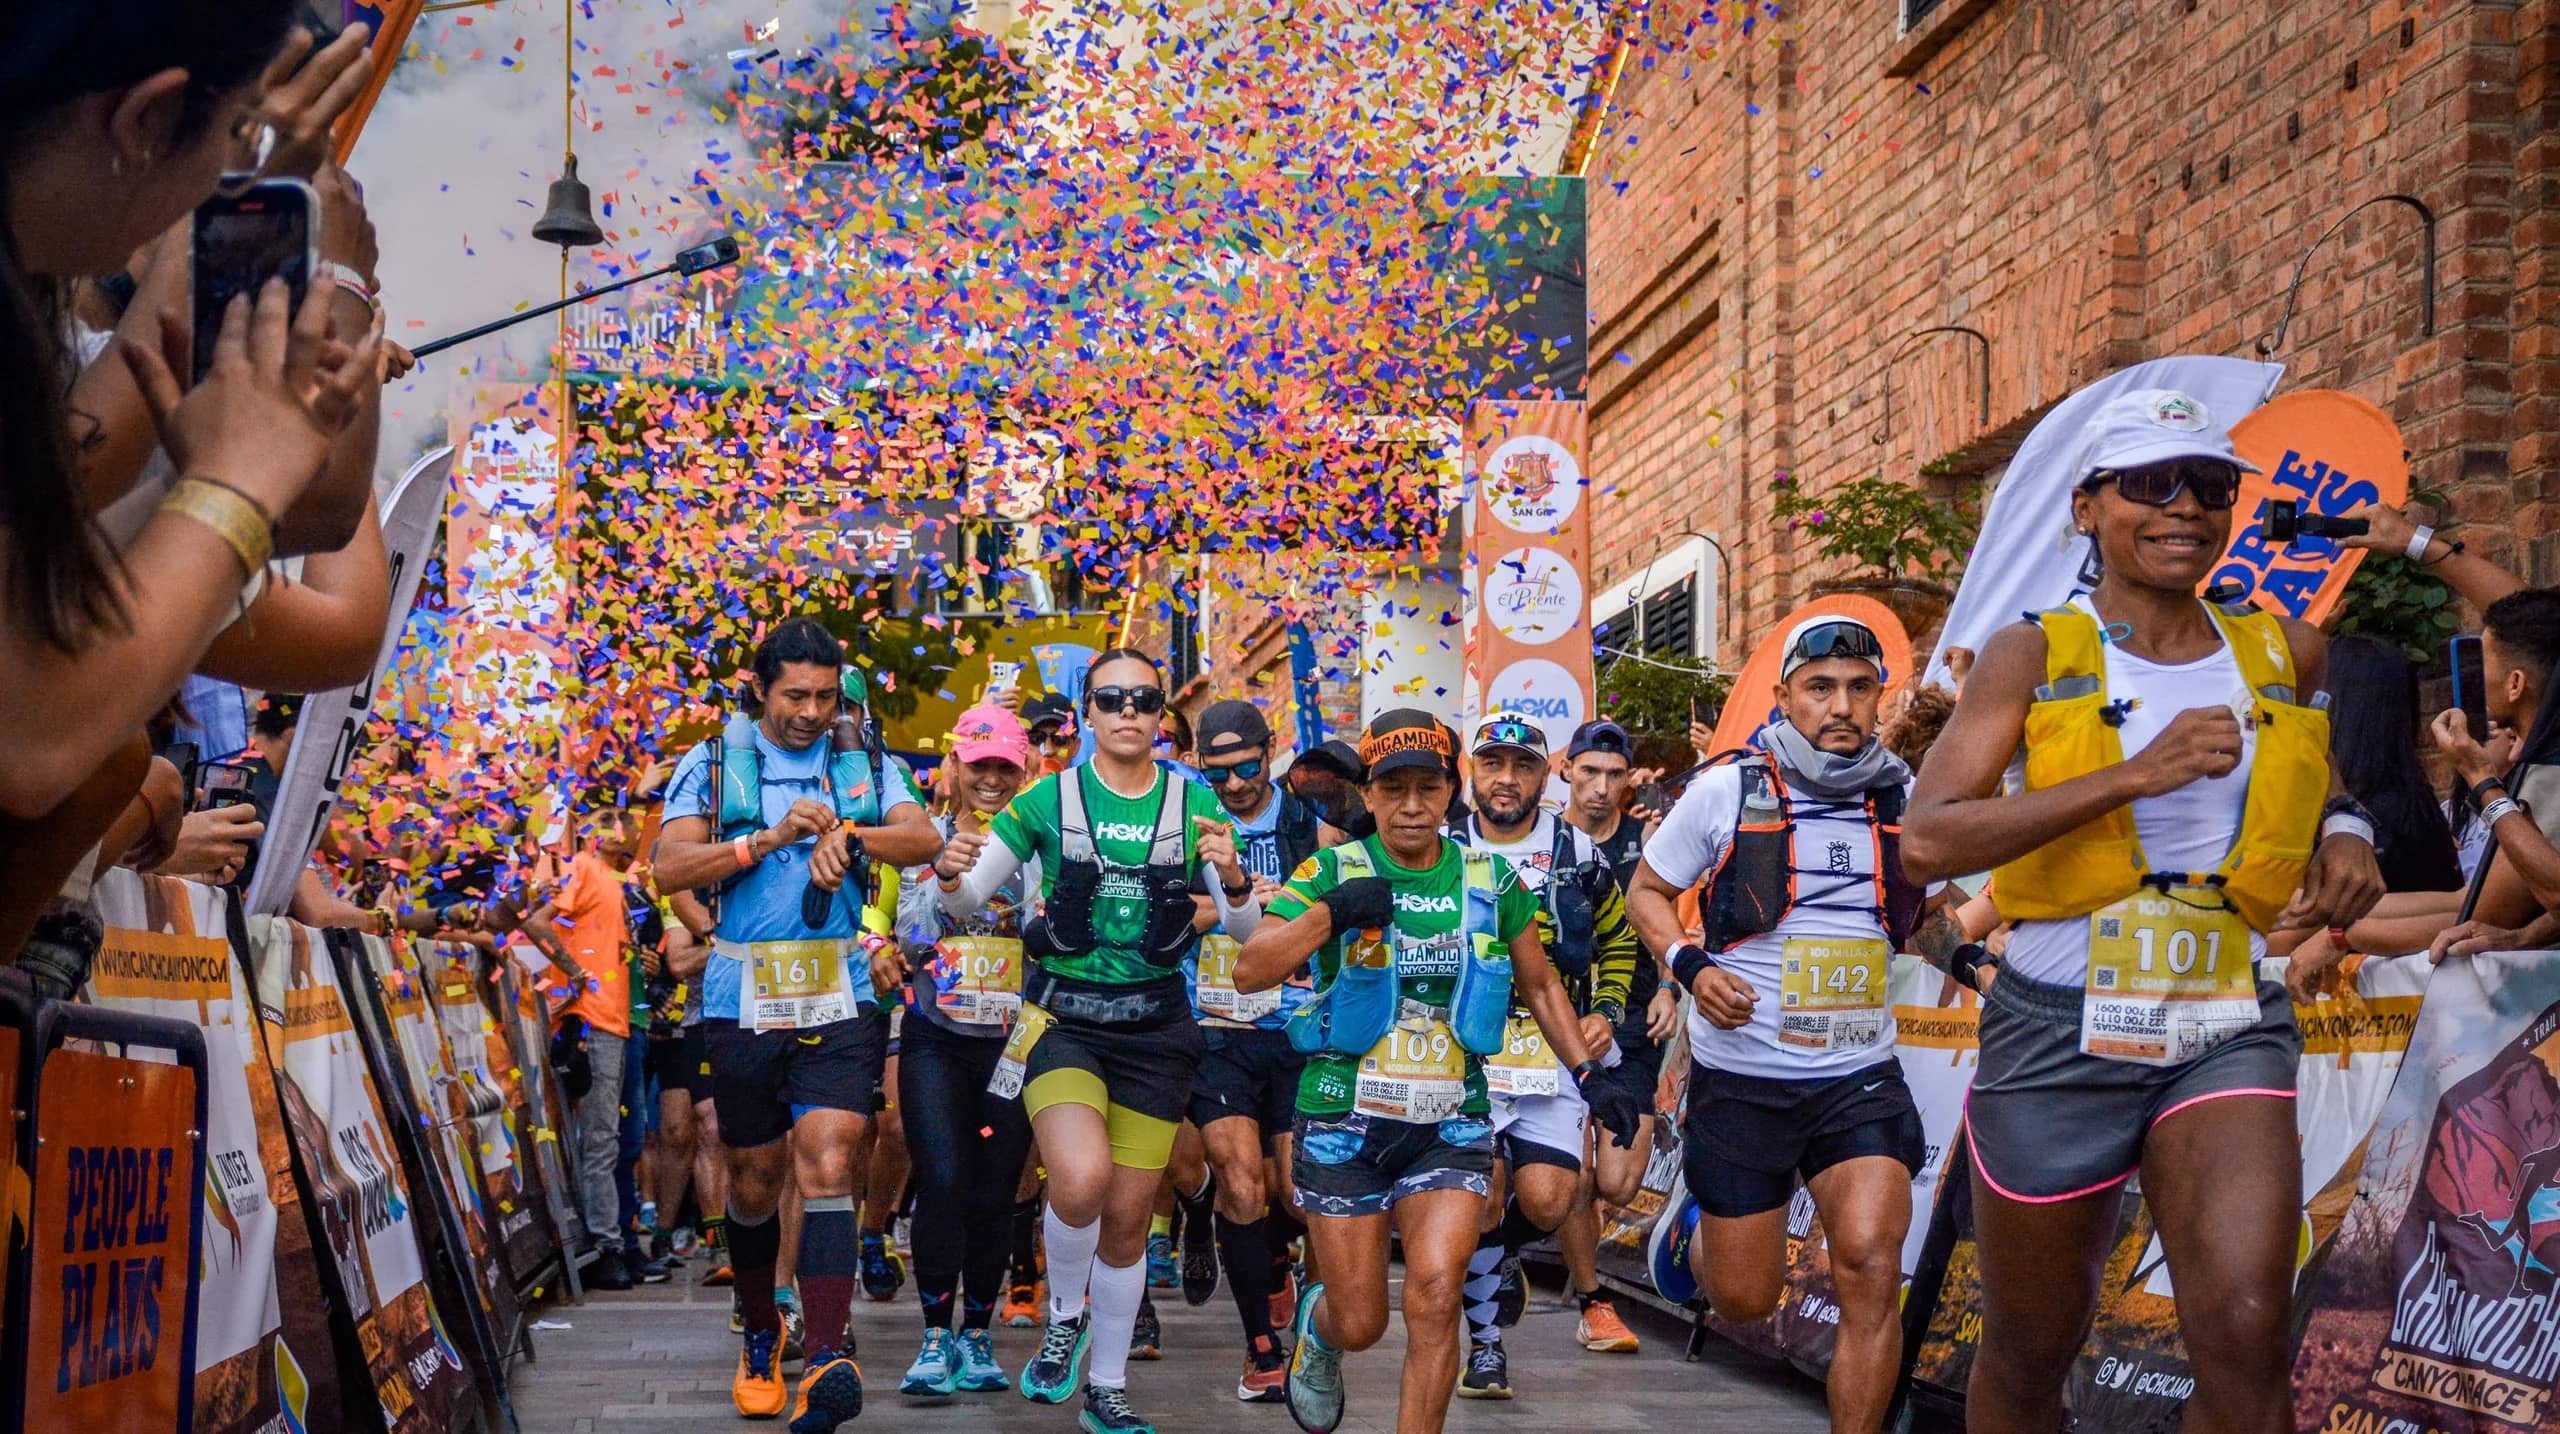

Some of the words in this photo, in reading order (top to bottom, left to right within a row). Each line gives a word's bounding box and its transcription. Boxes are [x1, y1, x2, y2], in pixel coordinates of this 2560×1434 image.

[1512, 508, 1533, 517] SAN
[1501, 699, 1569, 718] HOKA
[1363, 731, 1450, 762] CHICAMOCHA
[1392, 892, 1457, 912] HOKA
[2132, 928, 2221, 974] 101
[771, 957, 821, 985] 161
[1399, 965, 1435, 975] ANYON
[1808, 964, 1869, 994] 142
[2534, 1012, 2557, 1042] TRAIL
[1387, 1032, 1449, 1063] 109
[1509, 1033, 1541, 1056] 89
[1318, 1082, 1345, 1098] 2025
[63, 1145, 174, 1253] PEOPLE
